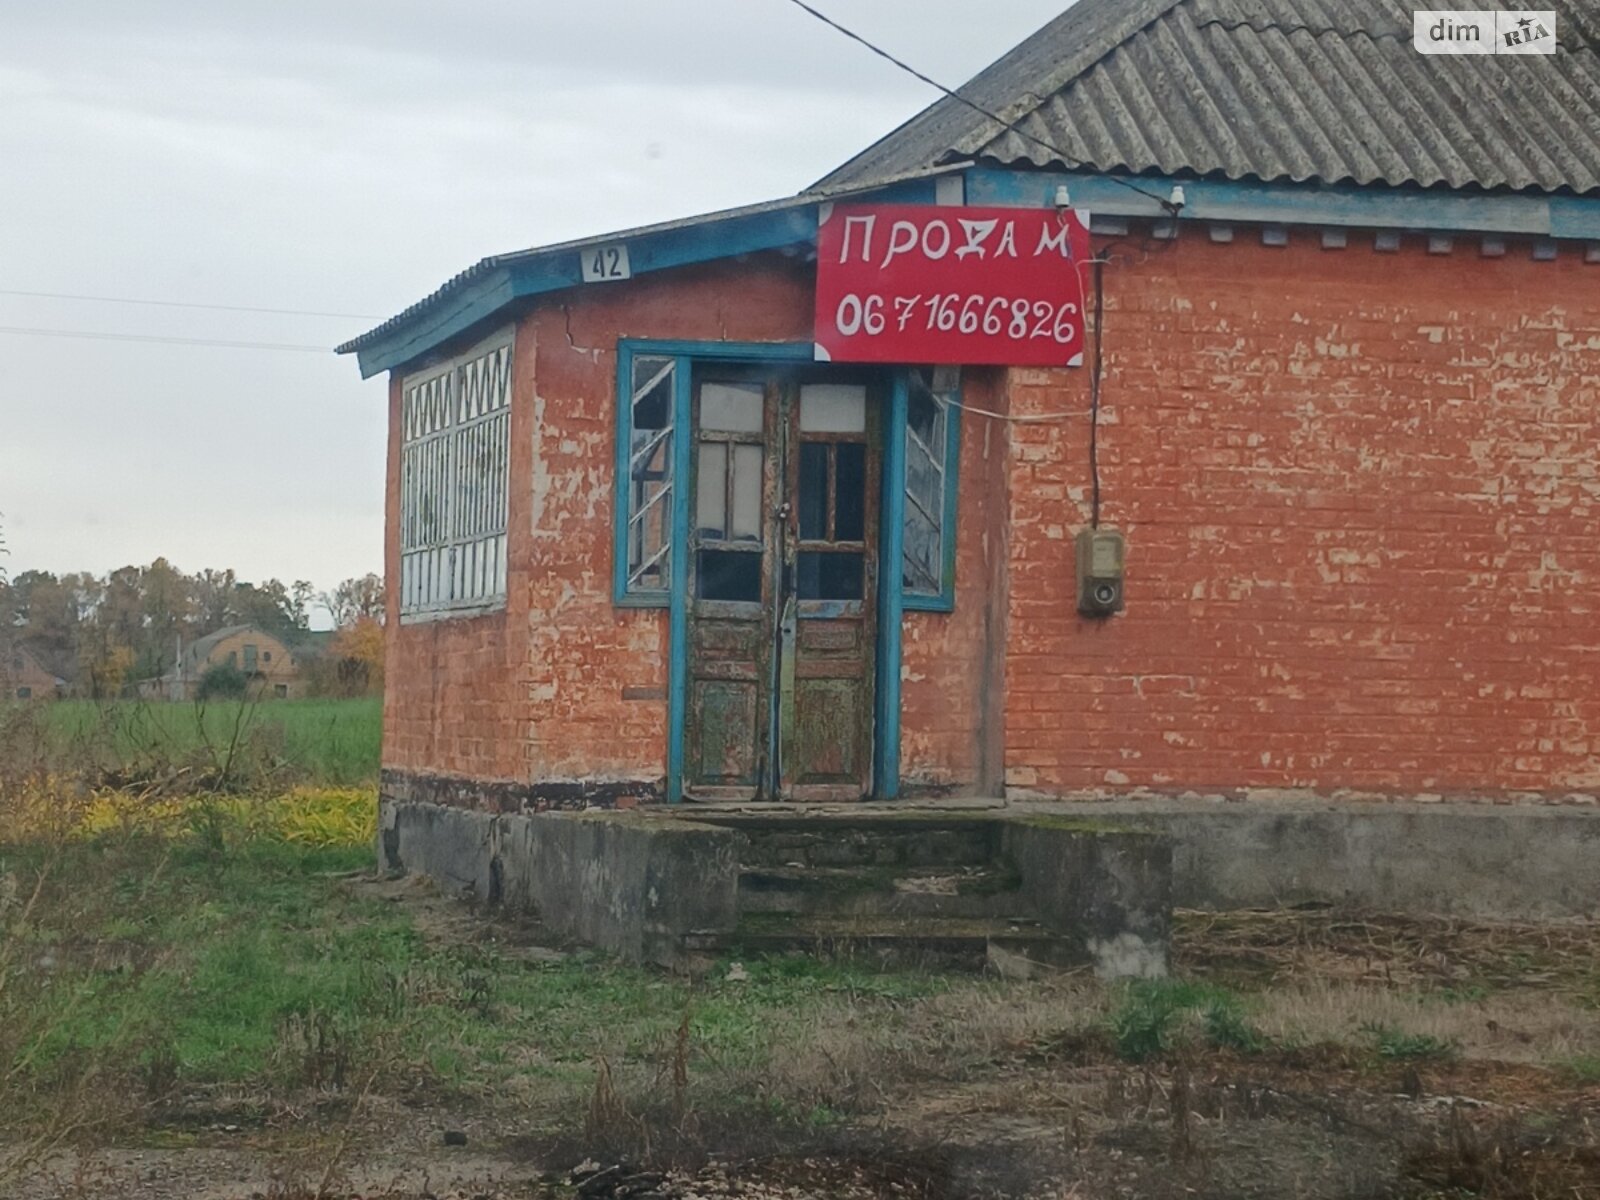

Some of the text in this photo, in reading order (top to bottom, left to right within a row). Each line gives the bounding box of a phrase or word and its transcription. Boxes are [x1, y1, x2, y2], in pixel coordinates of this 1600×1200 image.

[592, 247, 623, 278] 42
[839, 214, 1070, 270] ПРОДАМ
[835, 293, 1077, 344] 0671666826
